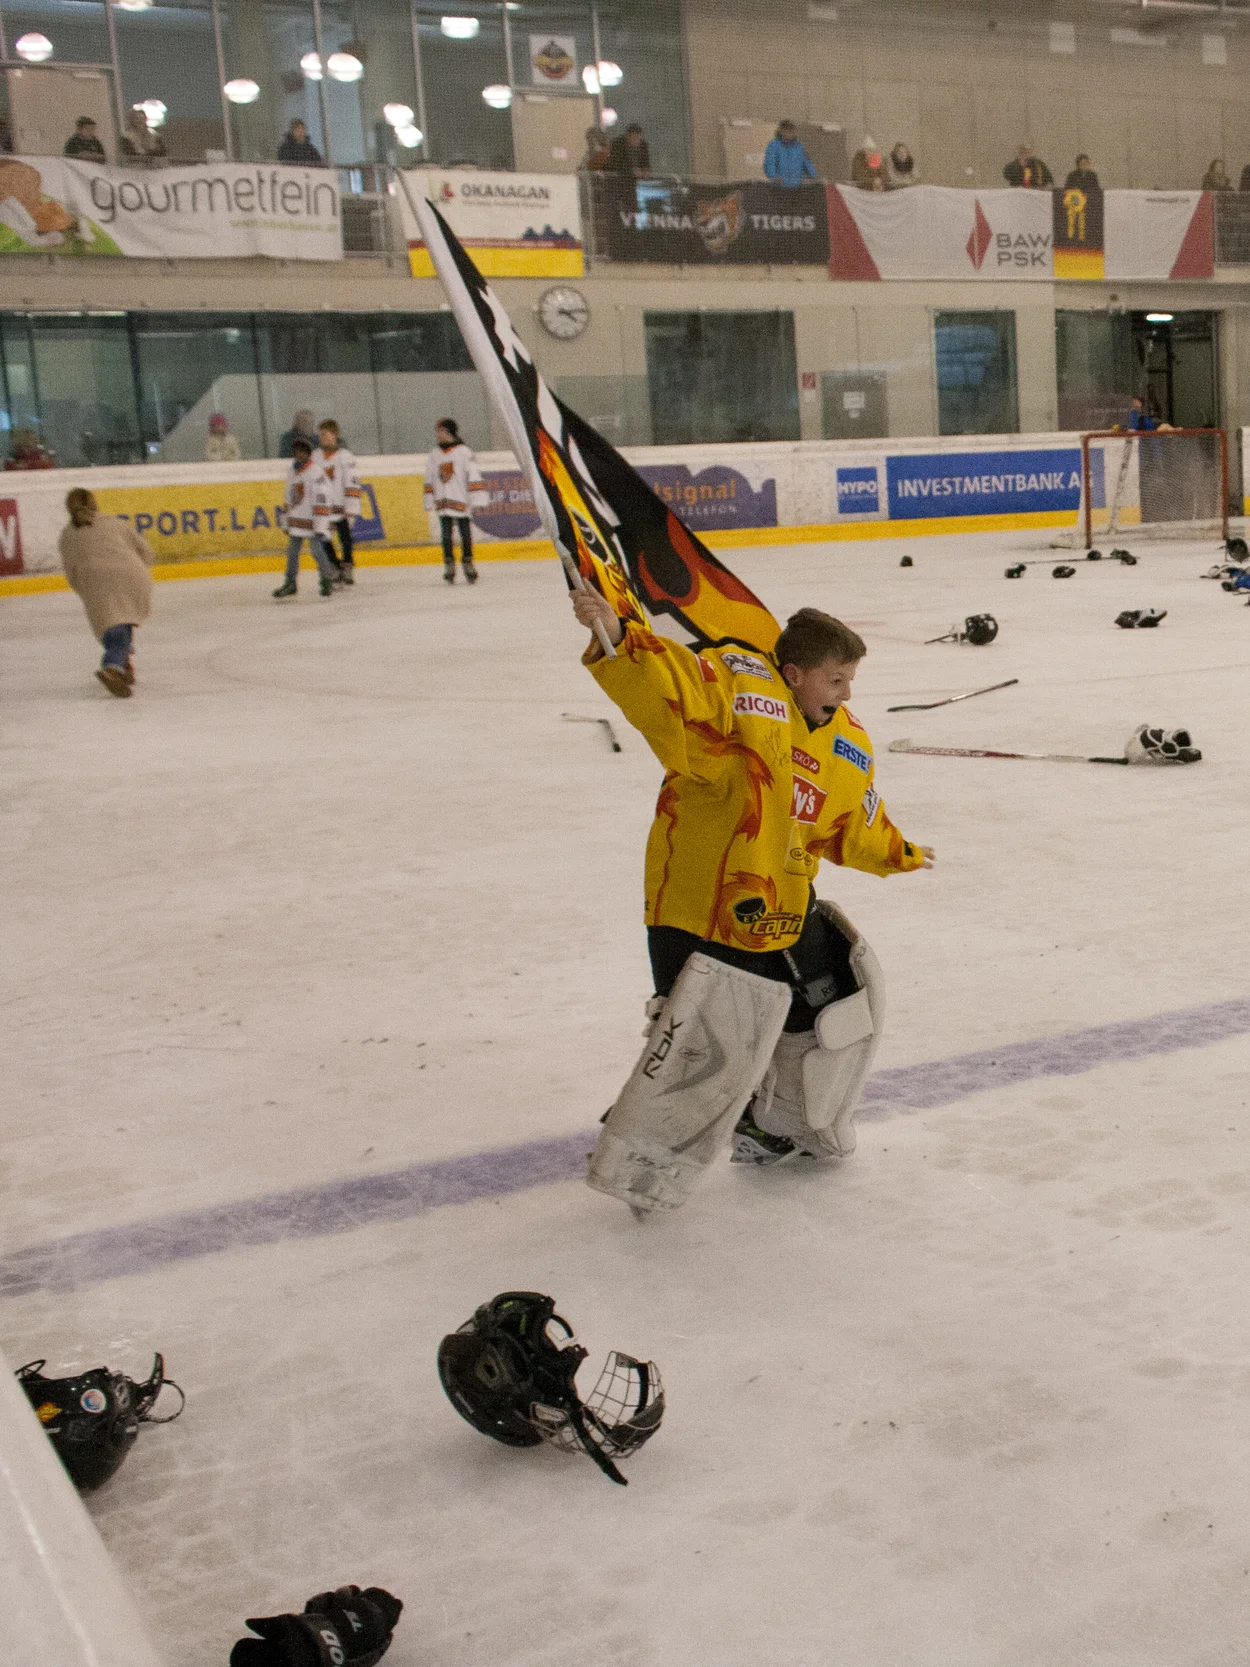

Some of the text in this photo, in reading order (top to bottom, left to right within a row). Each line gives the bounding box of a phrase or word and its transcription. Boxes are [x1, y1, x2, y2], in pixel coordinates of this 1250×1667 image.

[90, 169, 338, 223] gourmetfein
[460, 182, 549, 200] OKANAGAN
[750, 213, 816, 232] TIGERS
[997, 251, 1047, 267] PSK
[837, 481, 878, 495] HYPO
[897, 471, 1064, 498] INVESTMENTBANK
[734, 696, 787, 719] RICOH
[832, 738, 868, 773] ERSTE
